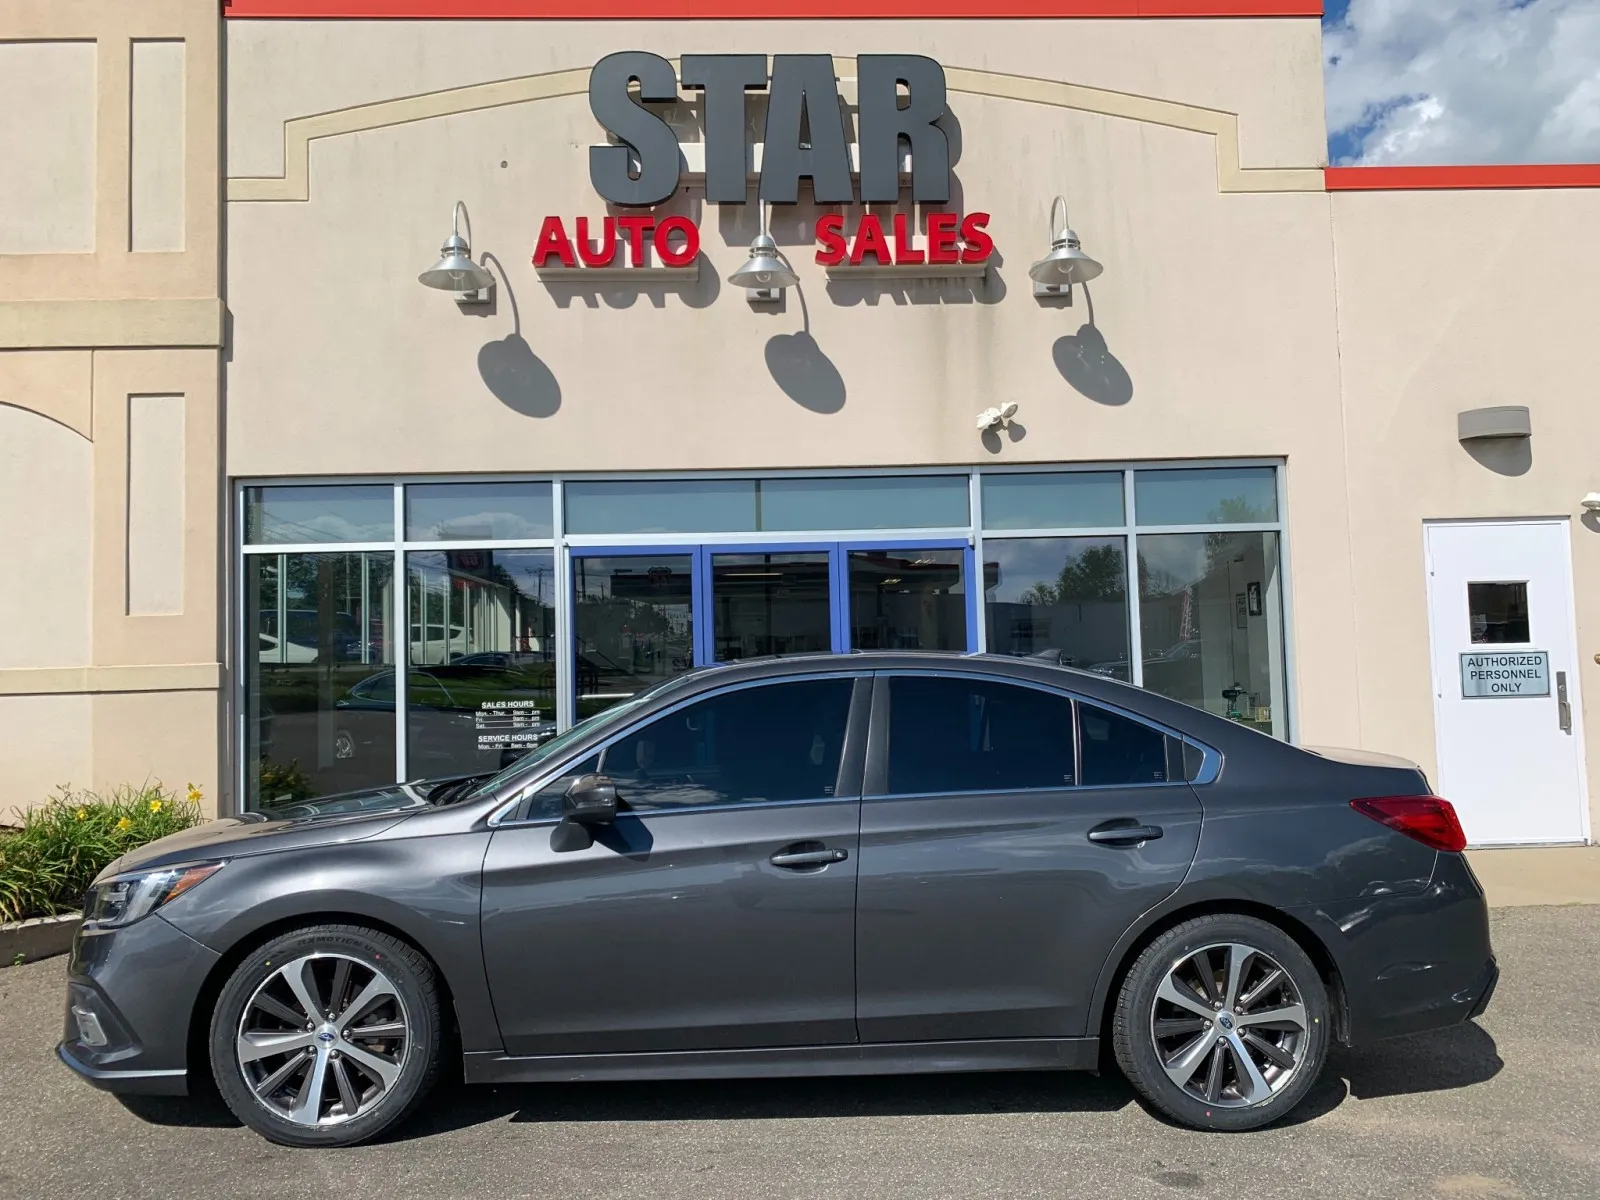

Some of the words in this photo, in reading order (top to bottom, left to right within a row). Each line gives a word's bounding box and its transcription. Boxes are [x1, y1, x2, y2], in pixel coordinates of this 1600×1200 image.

[589, 51, 950, 206] STAR
[532, 215, 700, 268] AUTO
[815, 212, 994, 267] SALES
[1468, 656, 1542, 667] AUTHORIZED
[1470, 669, 1541, 680] PERSONNEL
[1491, 683, 1522, 693] ONLY
[481, 701, 506, 709] SALES
[508, 700, 534, 708] HOURS
